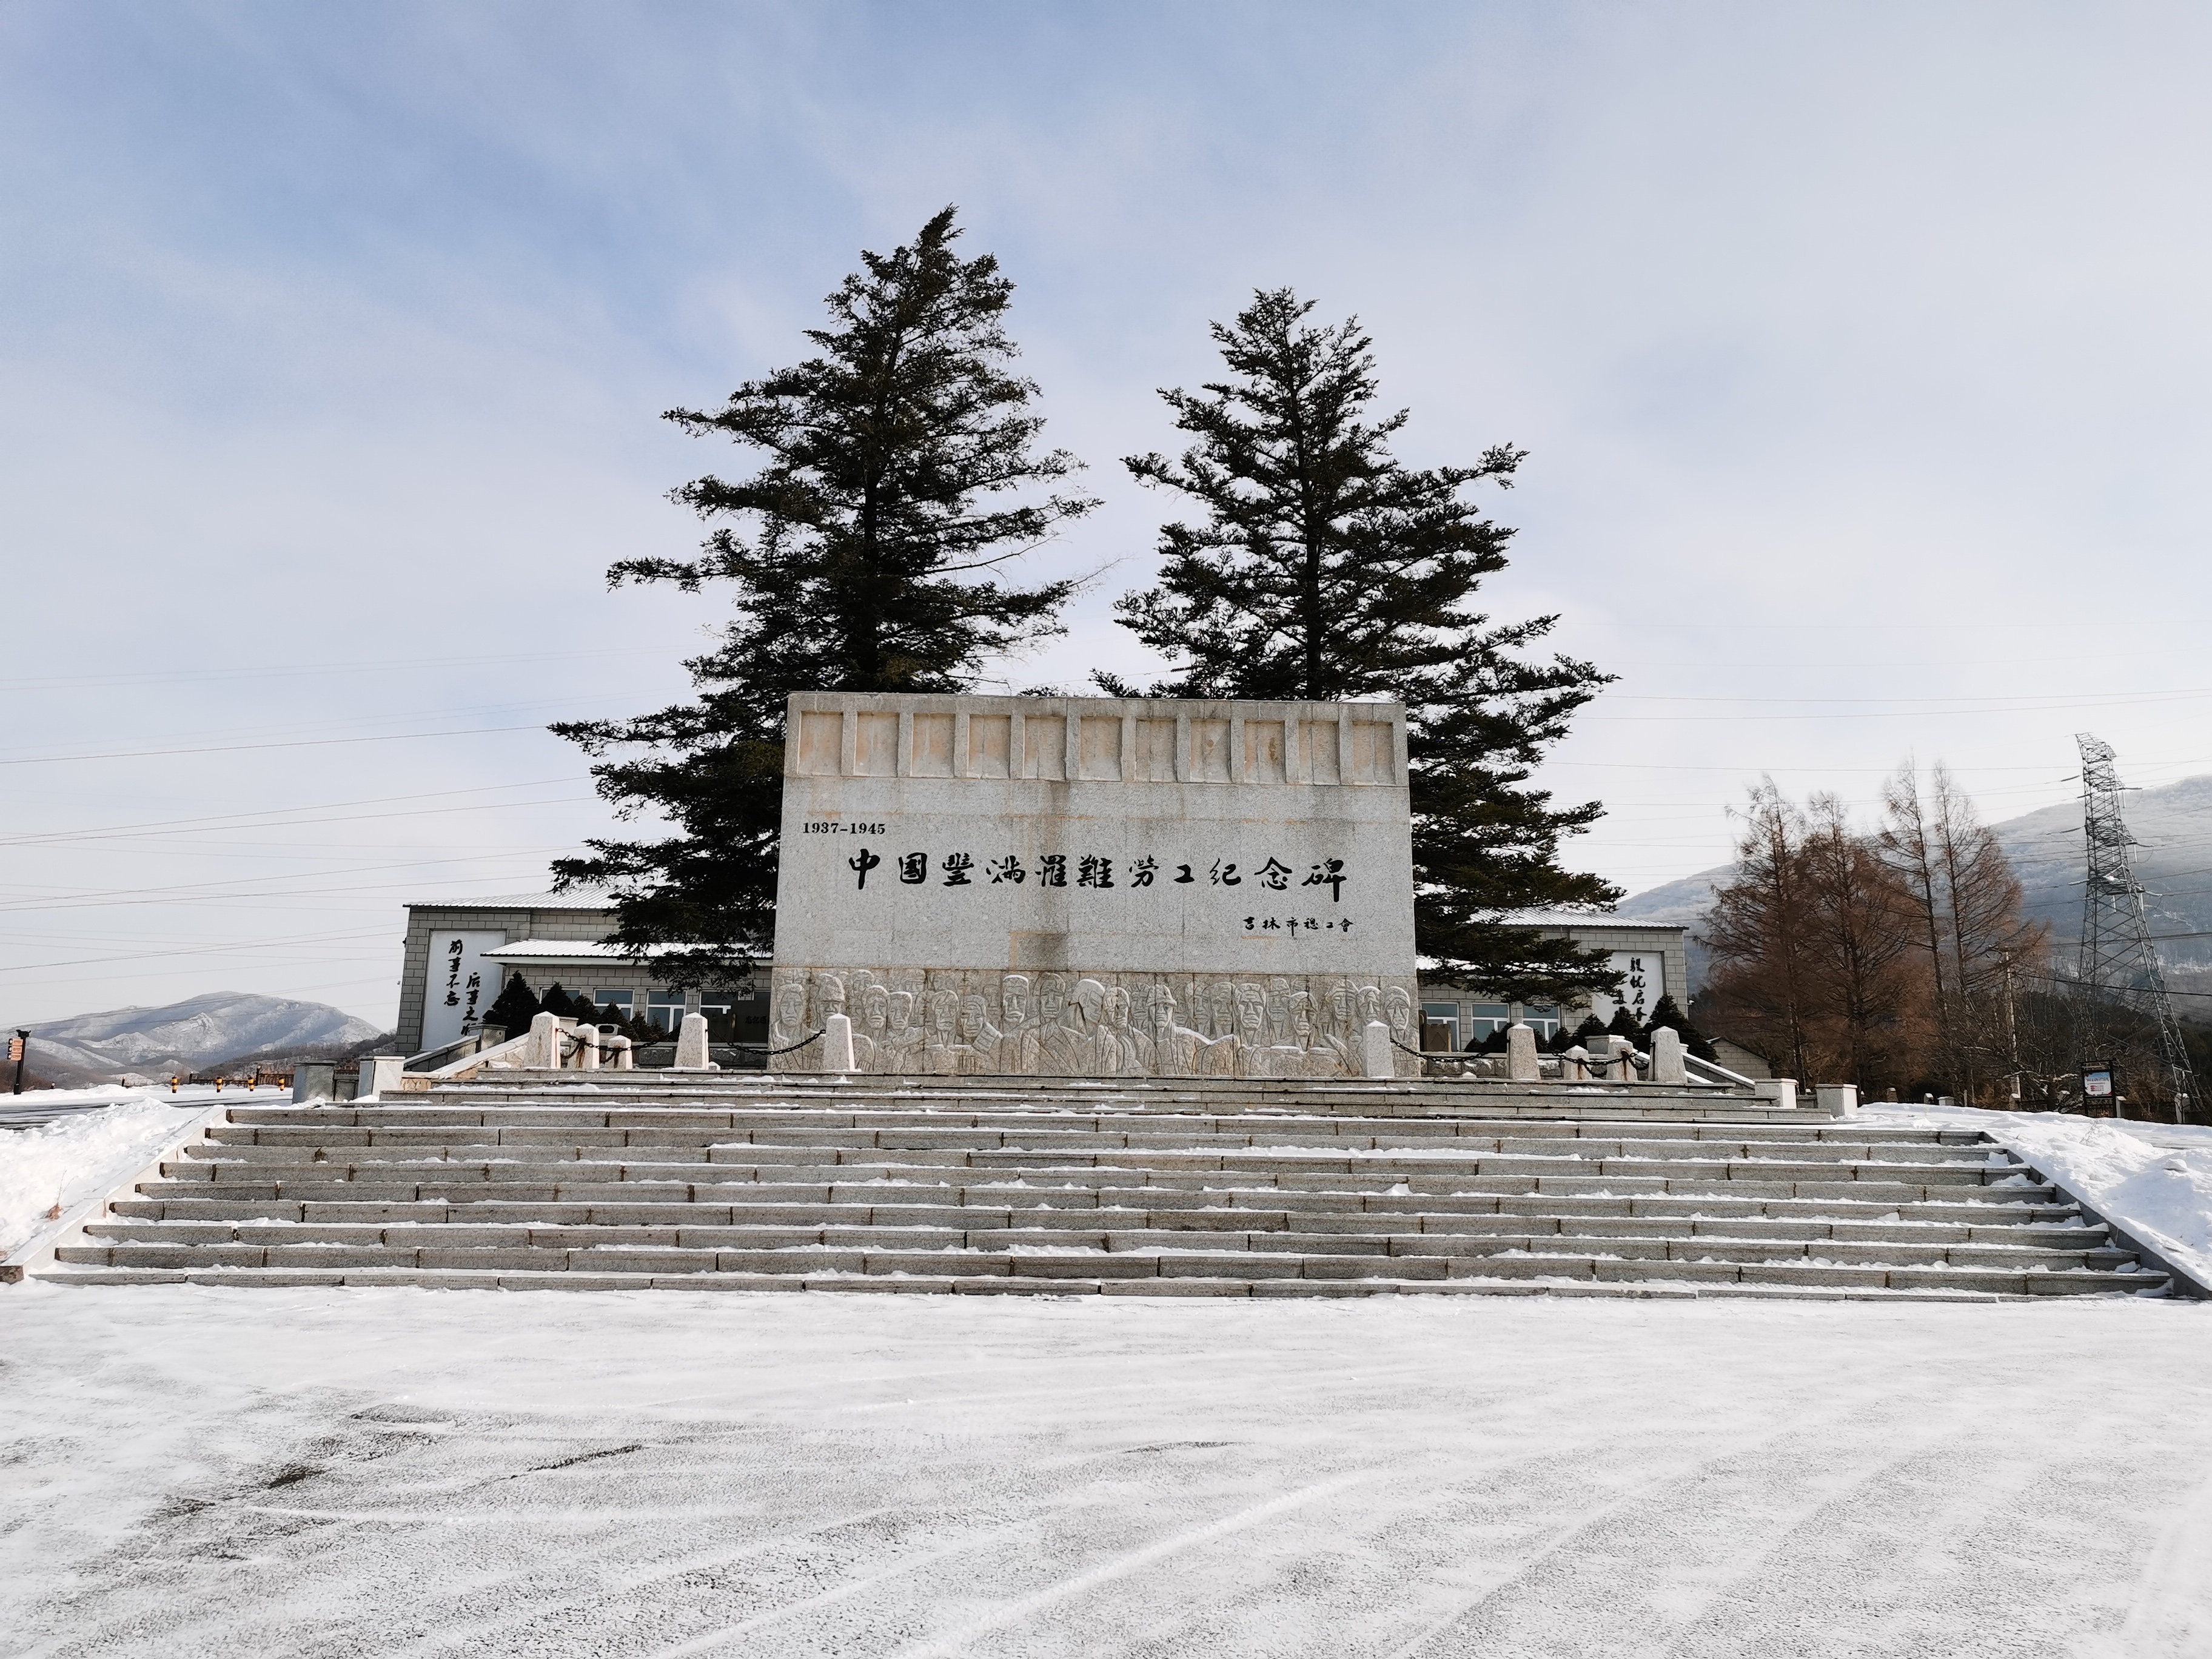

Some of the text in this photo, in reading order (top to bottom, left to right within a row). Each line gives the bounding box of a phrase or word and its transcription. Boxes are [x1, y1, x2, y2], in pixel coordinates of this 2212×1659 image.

[802, 822, 886, 835] 1937-1945
[443, 939, 463, 1007] 前事不忘
